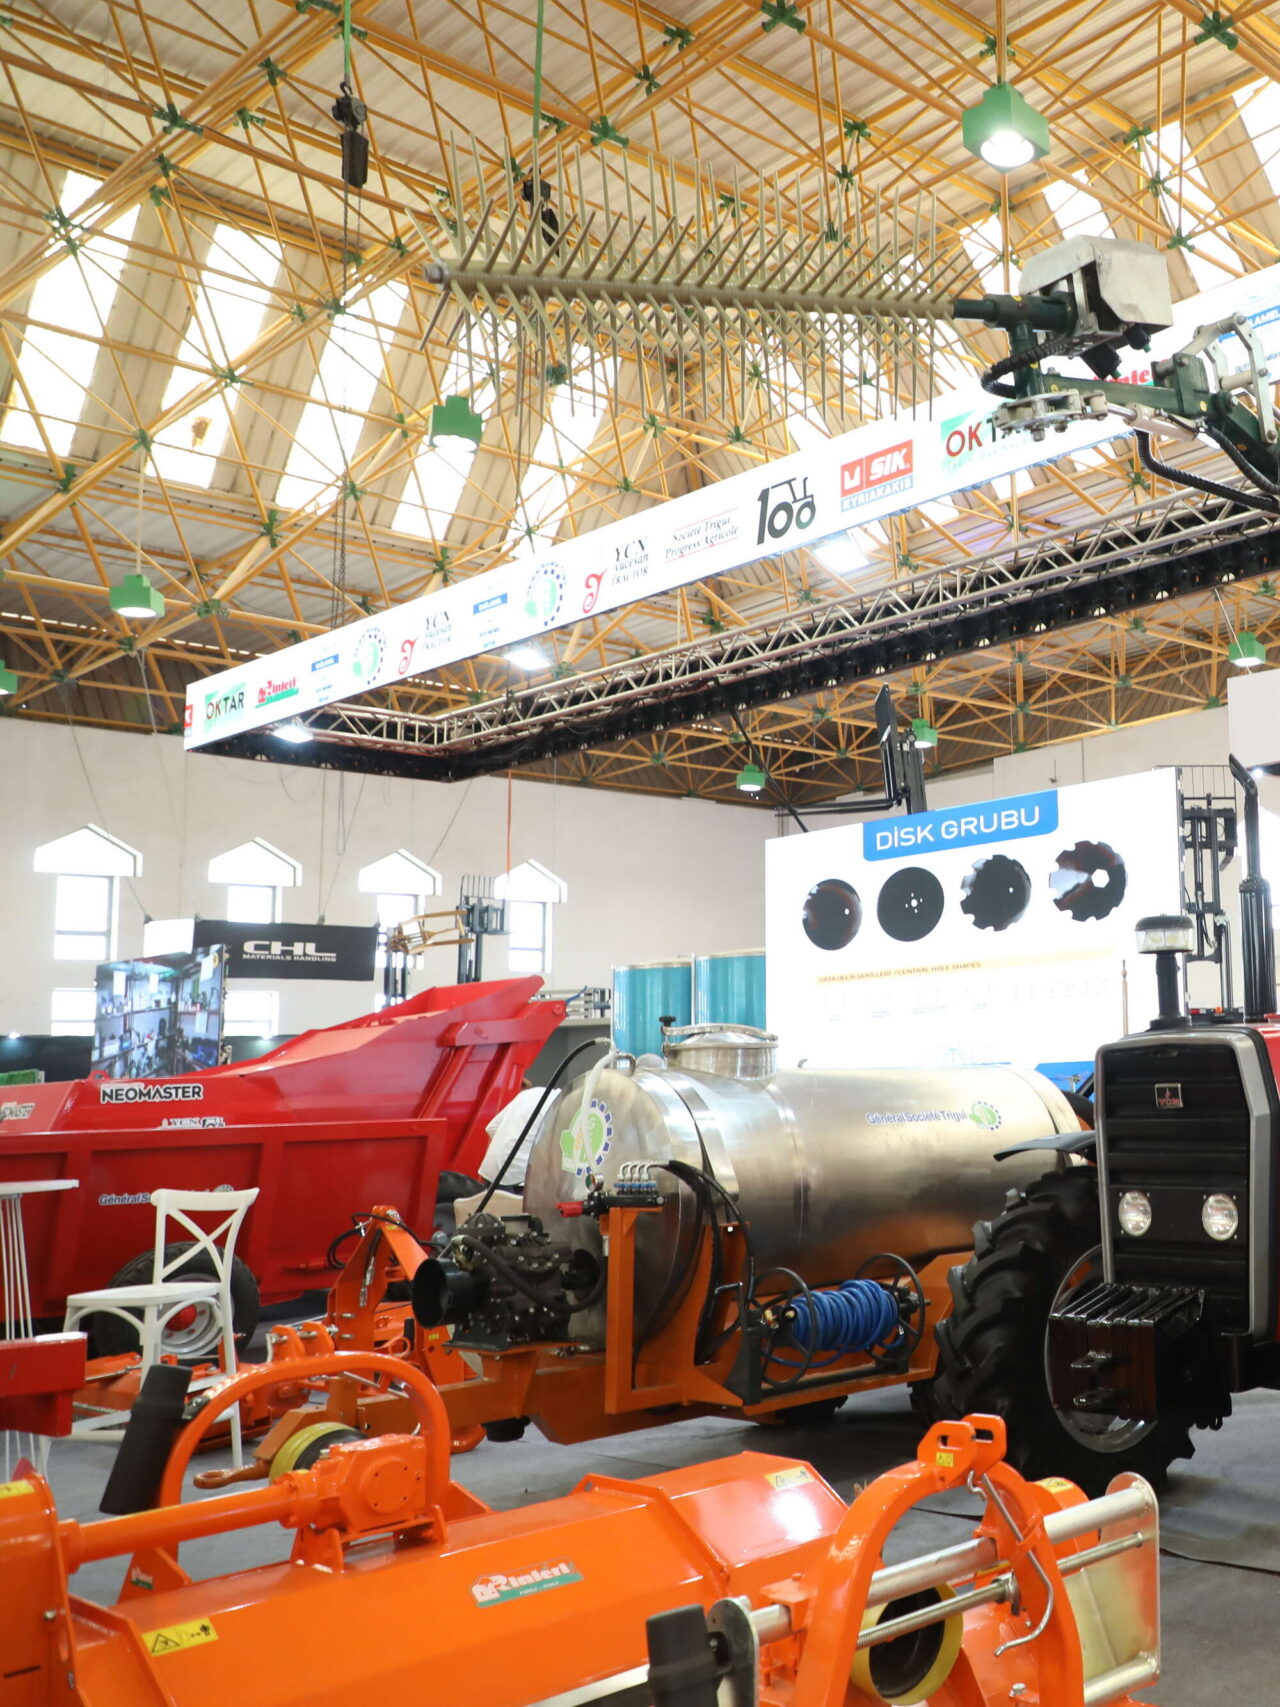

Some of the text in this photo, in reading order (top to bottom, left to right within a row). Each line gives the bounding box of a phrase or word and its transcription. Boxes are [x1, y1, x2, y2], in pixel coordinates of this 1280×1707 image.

[205, 692, 245, 720] OKTAR
[941, 805, 1040, 840] GRUBU
[243, 940, 337, 957] CHL
[242, 953, 337, 963] MATERIALS HANDLING
[102, 1085, 202, 1102] NEOMASTER
[866, 1110, 968, 1124] Général Société Trigui
[100, 1195, 142, 1205] Général
